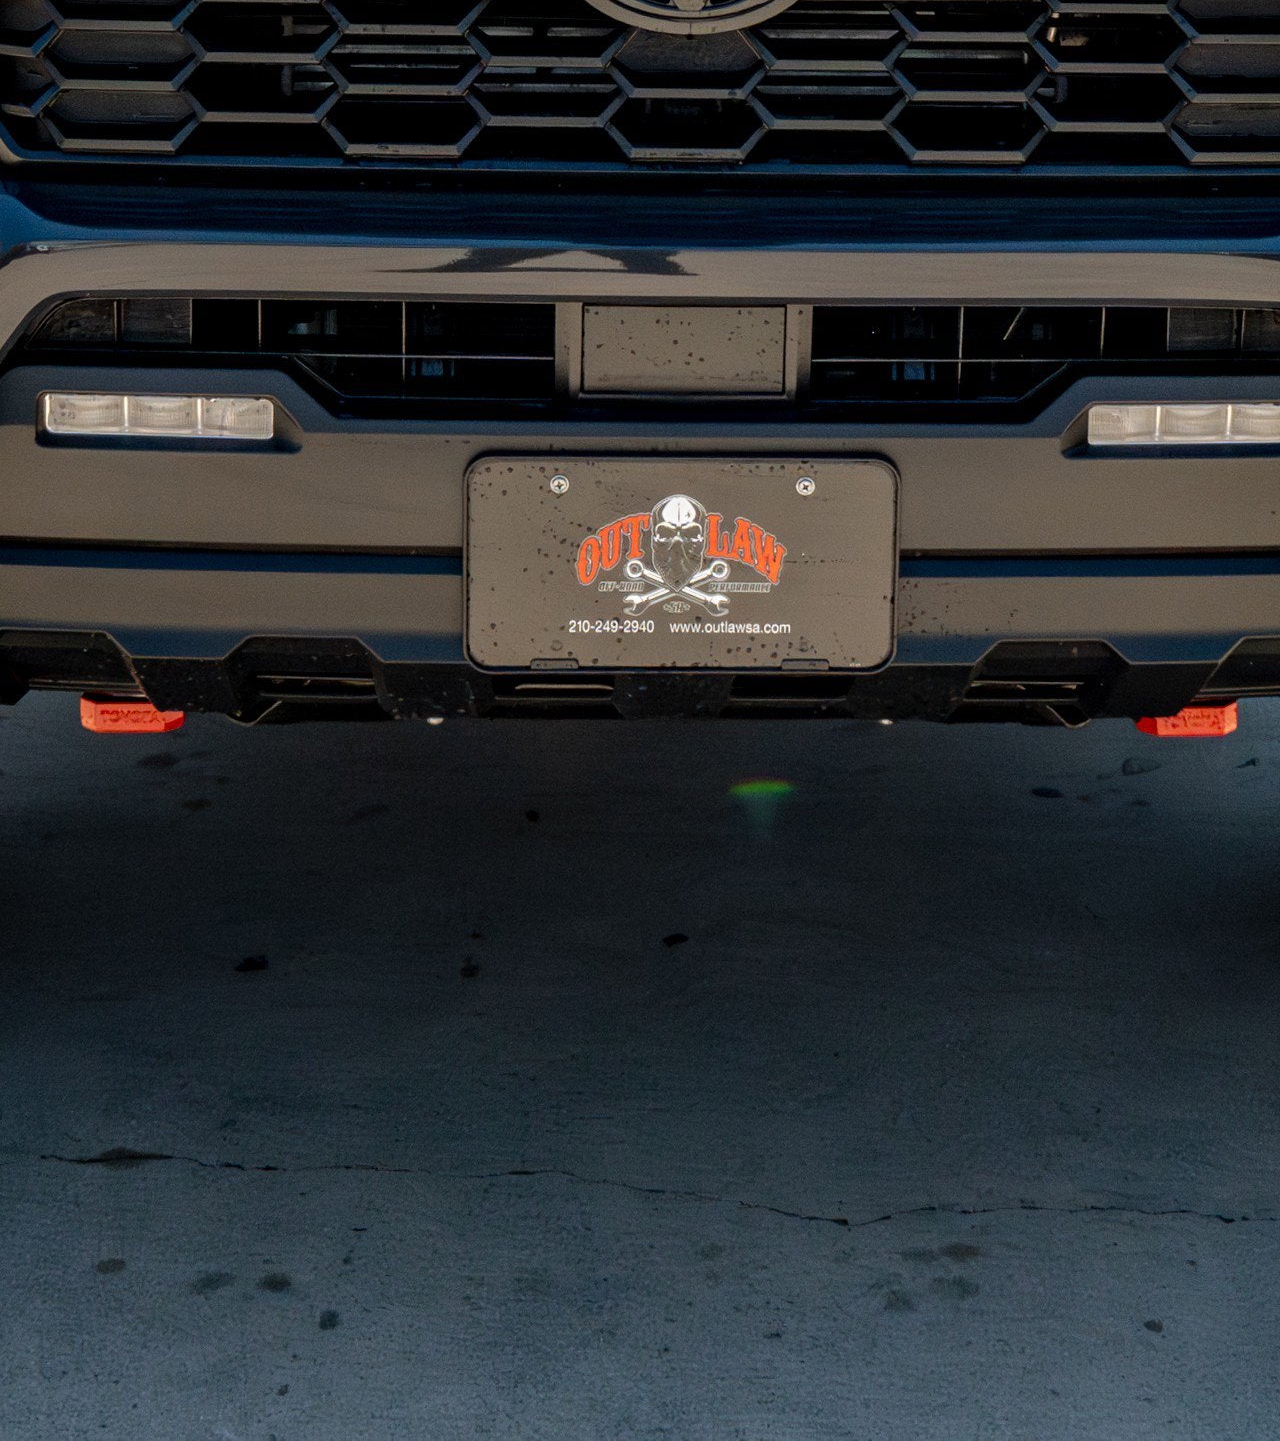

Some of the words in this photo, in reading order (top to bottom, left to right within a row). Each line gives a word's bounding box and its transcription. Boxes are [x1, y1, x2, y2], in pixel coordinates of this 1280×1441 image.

[575, 512, 653, 586] OUT
[705, 512, 787, 586] LAW
[708, 582, 771, 593] PERFORMANCE
[568, 619, 655, 633] 210-249-2940
[670, 620, 791, 633] www.outlawsa.com
